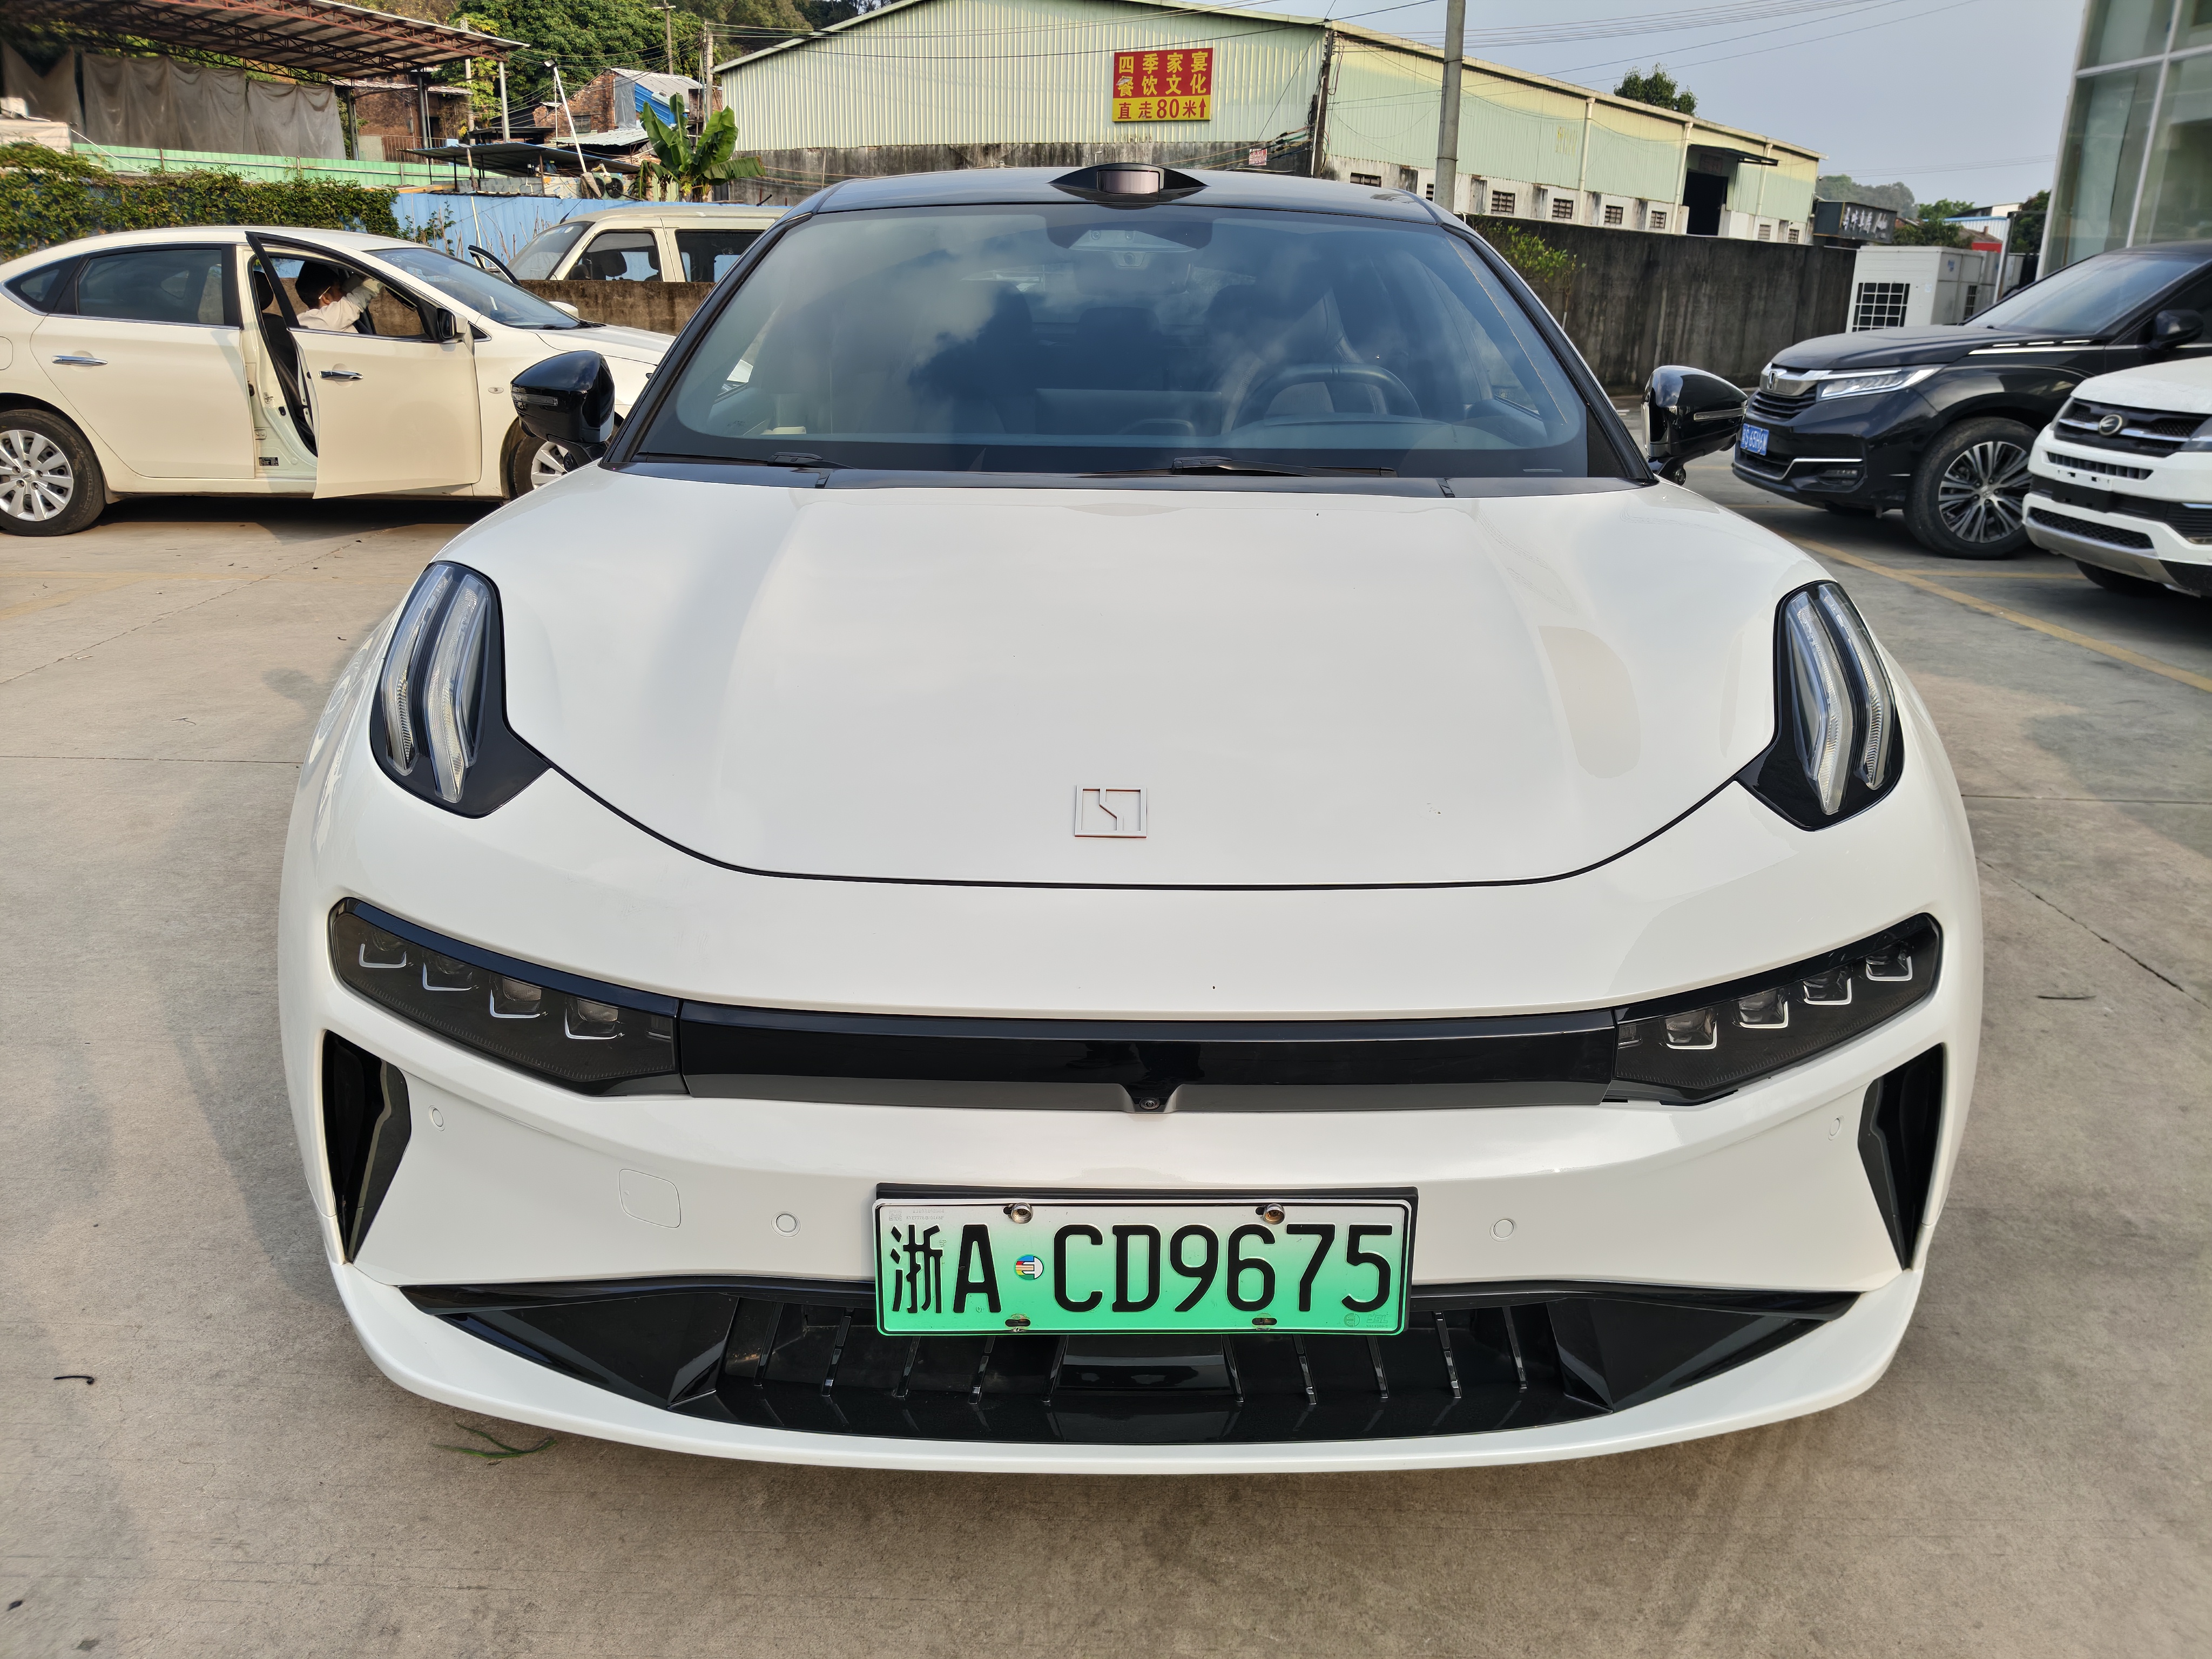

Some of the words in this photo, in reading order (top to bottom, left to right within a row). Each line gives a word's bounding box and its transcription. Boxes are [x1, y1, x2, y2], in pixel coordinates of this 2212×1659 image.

[1118, 51, 1208, 74] 四季家宴
[1117, 98, 1197, 119] 直走80米
[1053, 1223, 1393, 1313] CD9675
